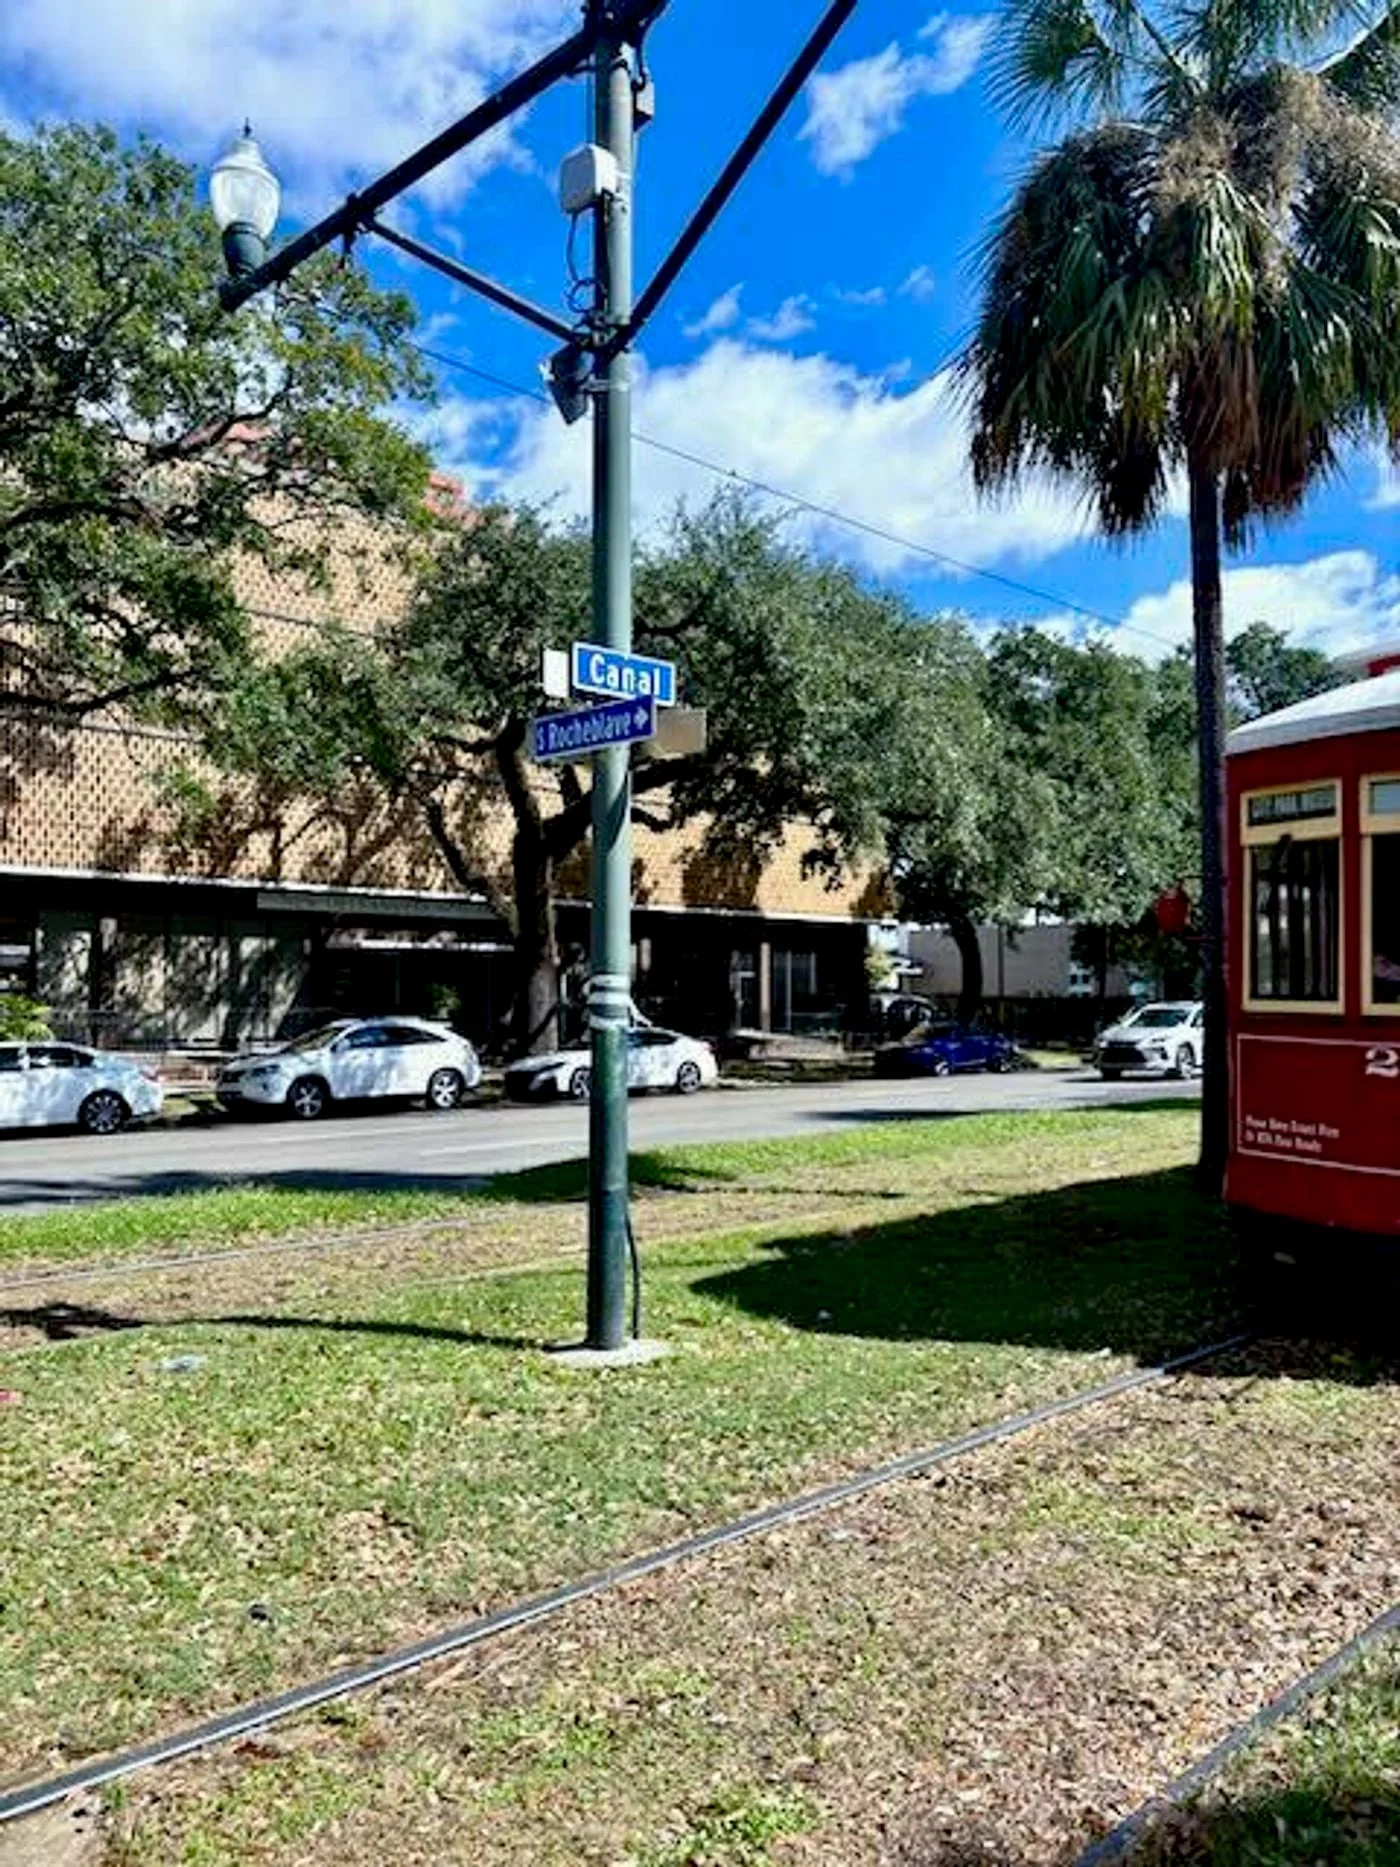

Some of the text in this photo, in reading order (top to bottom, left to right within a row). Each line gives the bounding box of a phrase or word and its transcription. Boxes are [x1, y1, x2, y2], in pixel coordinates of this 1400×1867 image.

[589, 653, 661, 696] Canal
[537, 711, 631, 751] S Rocheblave
